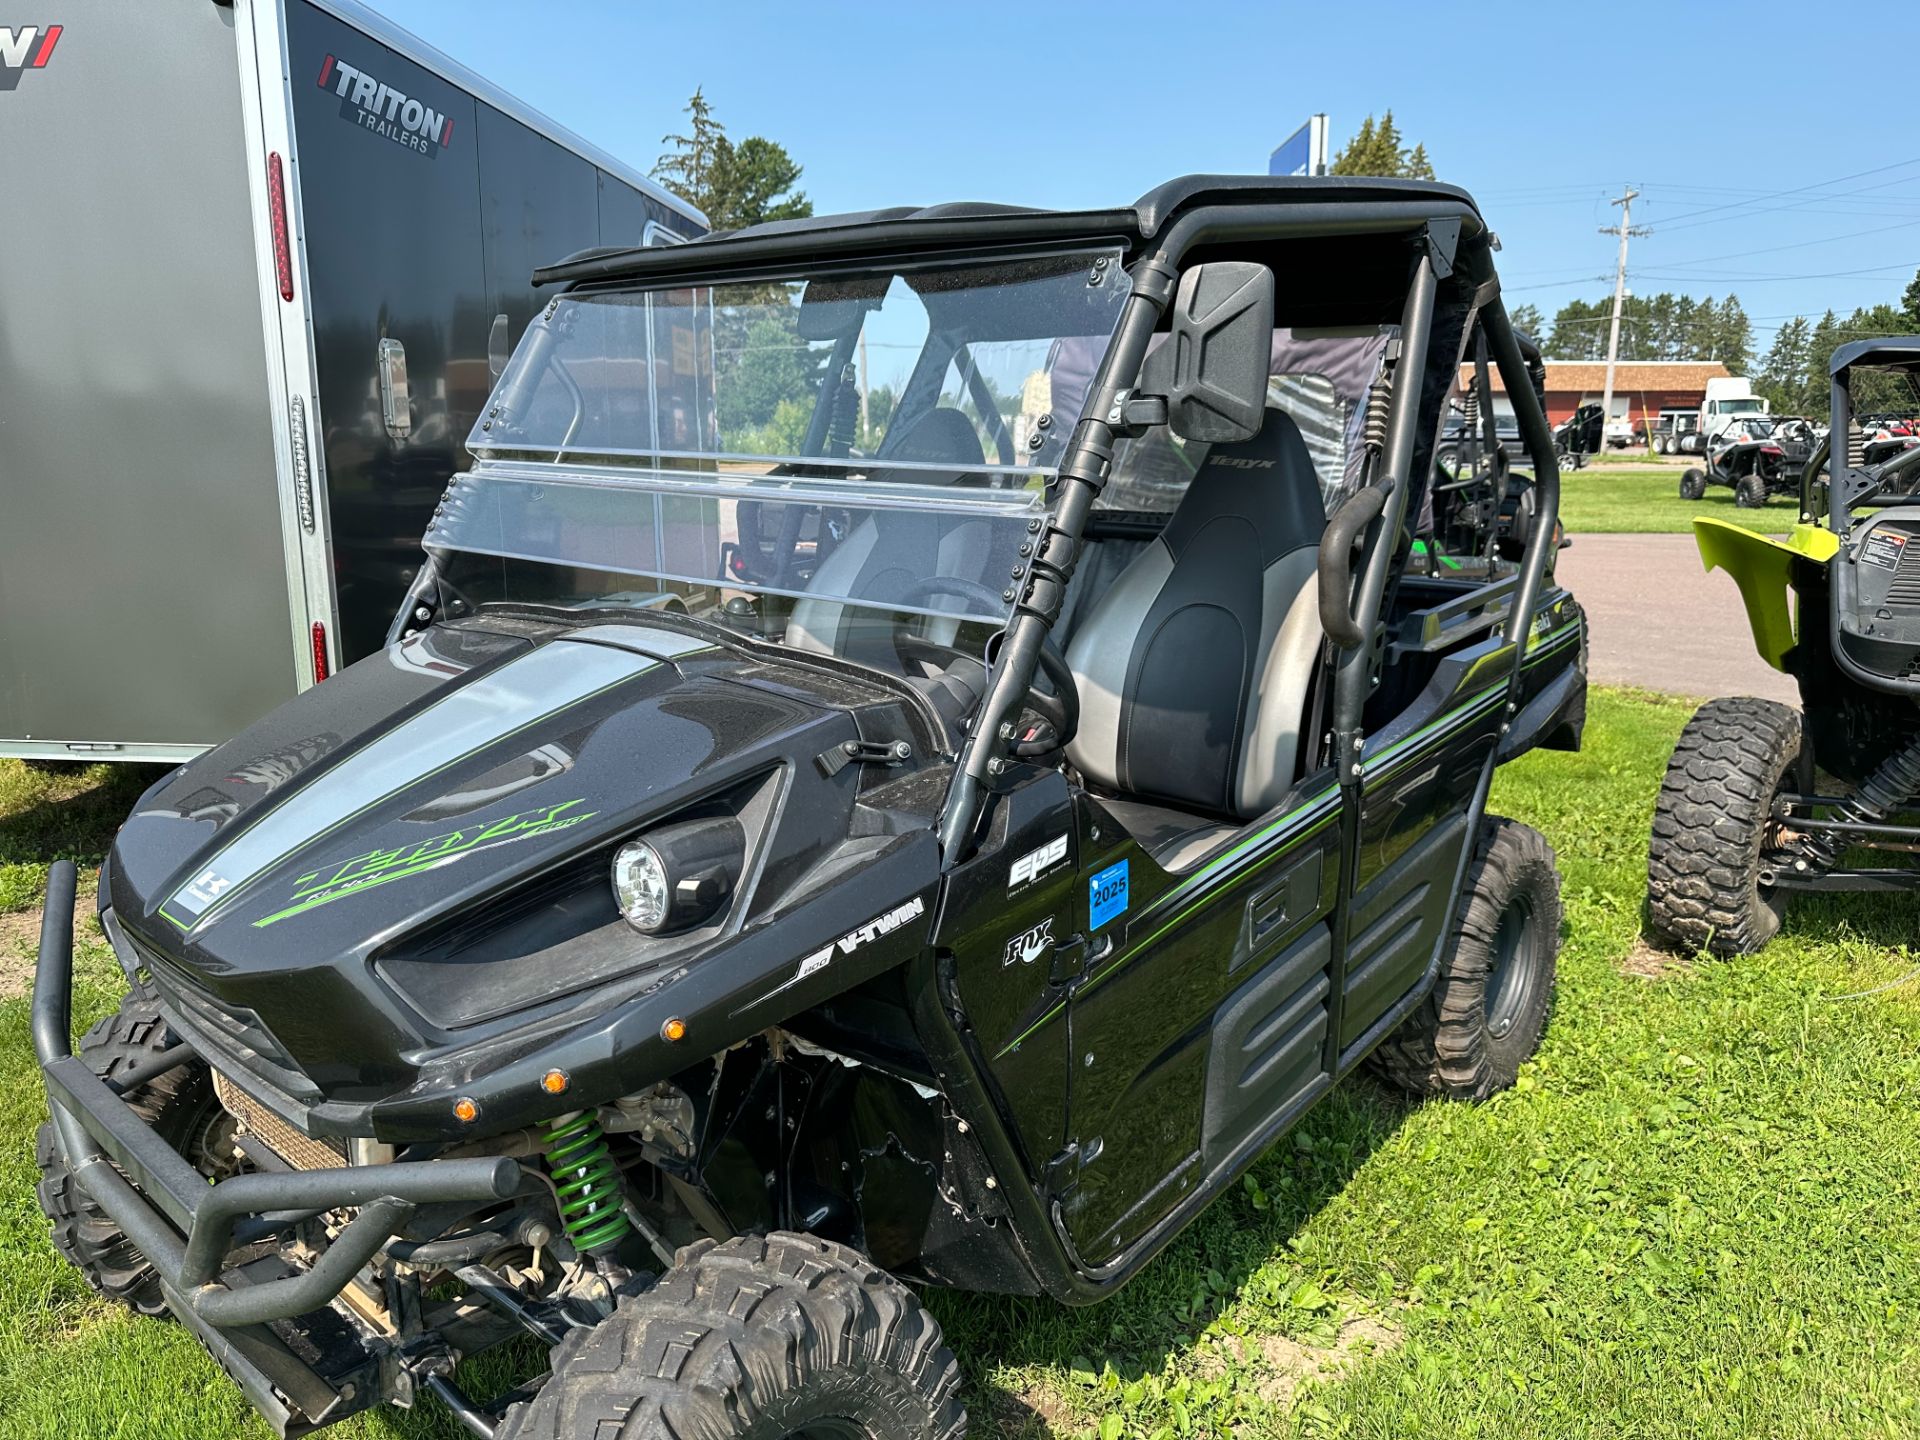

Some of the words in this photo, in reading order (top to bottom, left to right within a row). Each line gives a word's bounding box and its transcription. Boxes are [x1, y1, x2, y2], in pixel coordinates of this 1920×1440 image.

[336, 60, 445, 143] TRITON
[357, 109, 429, 154] TRAILERS
[1008, 833, 1069, 888] EPS
[1094, 876, 1127, 908] 2025
[837, 896, 924, 954] V-TWIN
[1005, 918, 1054, 966] FOX
